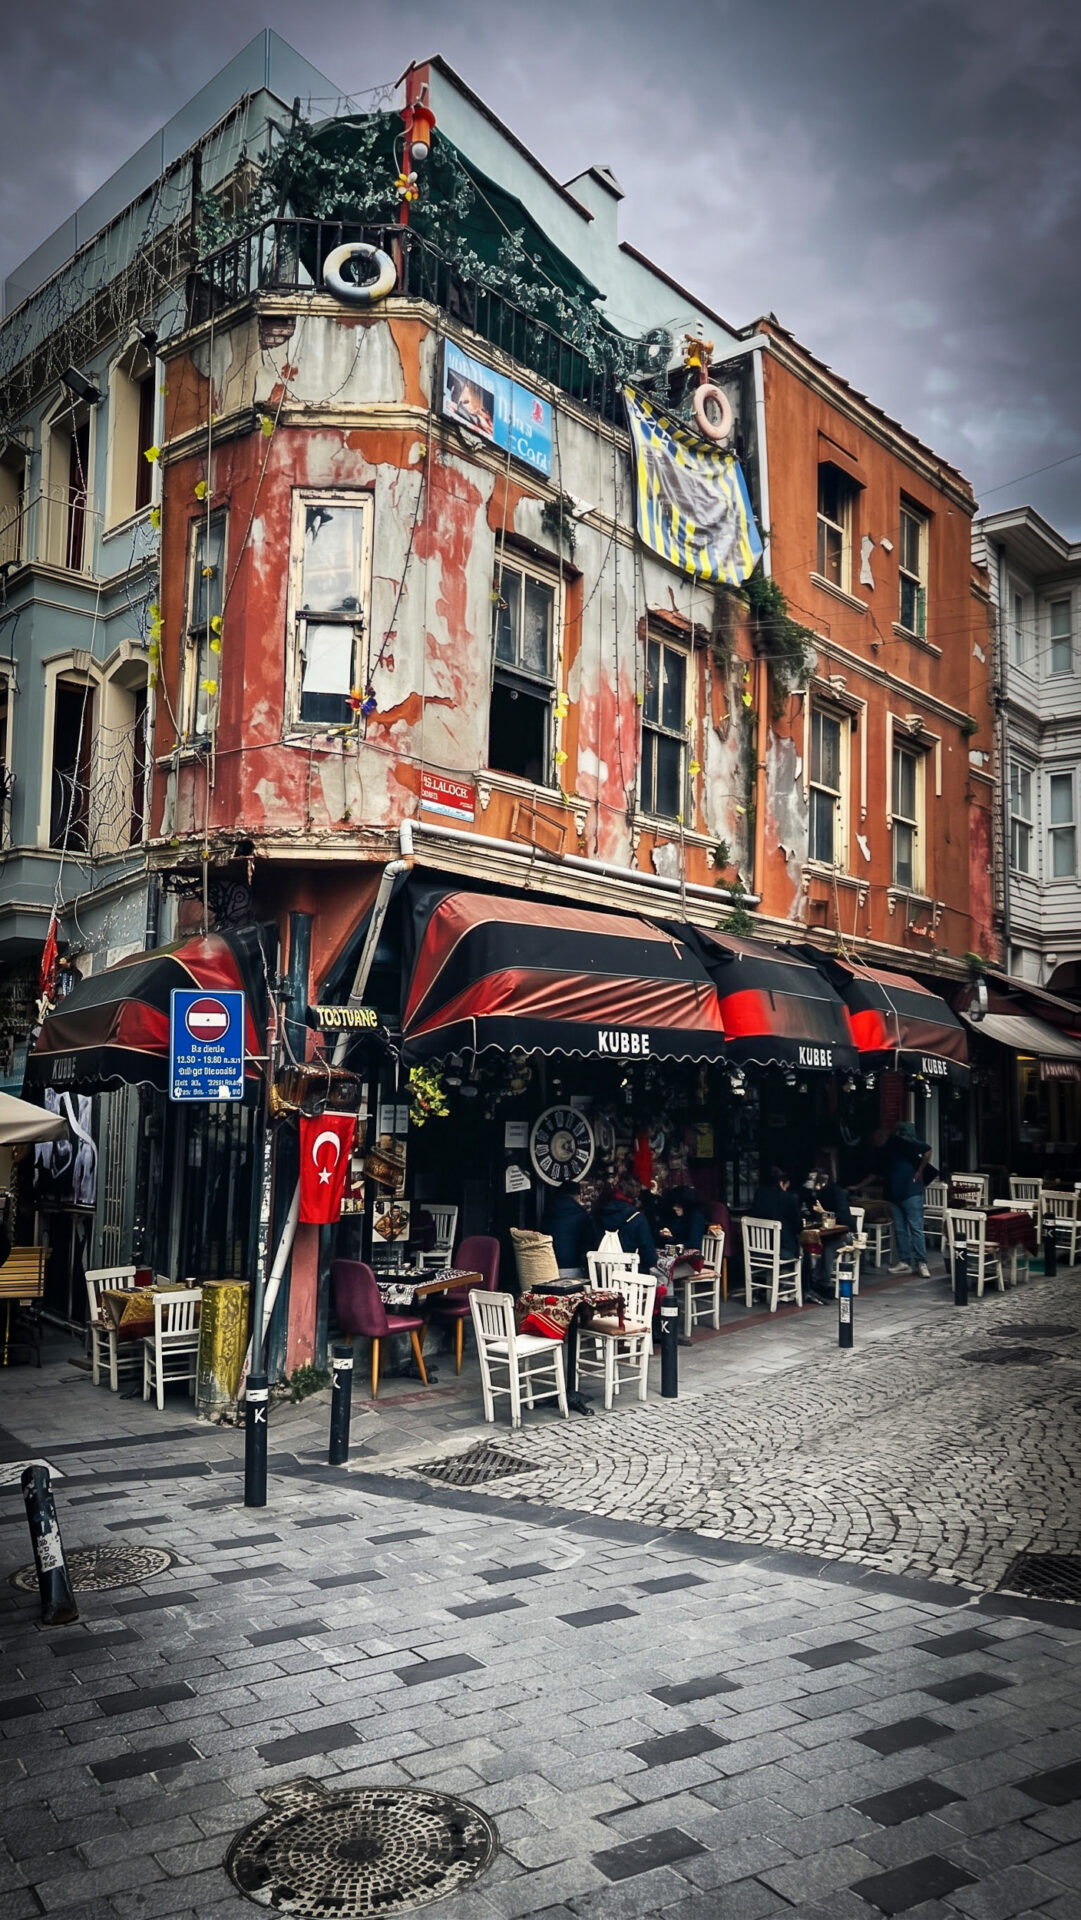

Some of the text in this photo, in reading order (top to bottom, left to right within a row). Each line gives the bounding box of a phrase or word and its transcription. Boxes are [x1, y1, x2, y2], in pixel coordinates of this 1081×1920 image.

[598, 1031, 650, 1054] KUBBE
[798, 1046, 833, 1067] KUBBE
[921, 1057, 948, 1075] KUBBE
[254, 1407, 266, 1424] K
